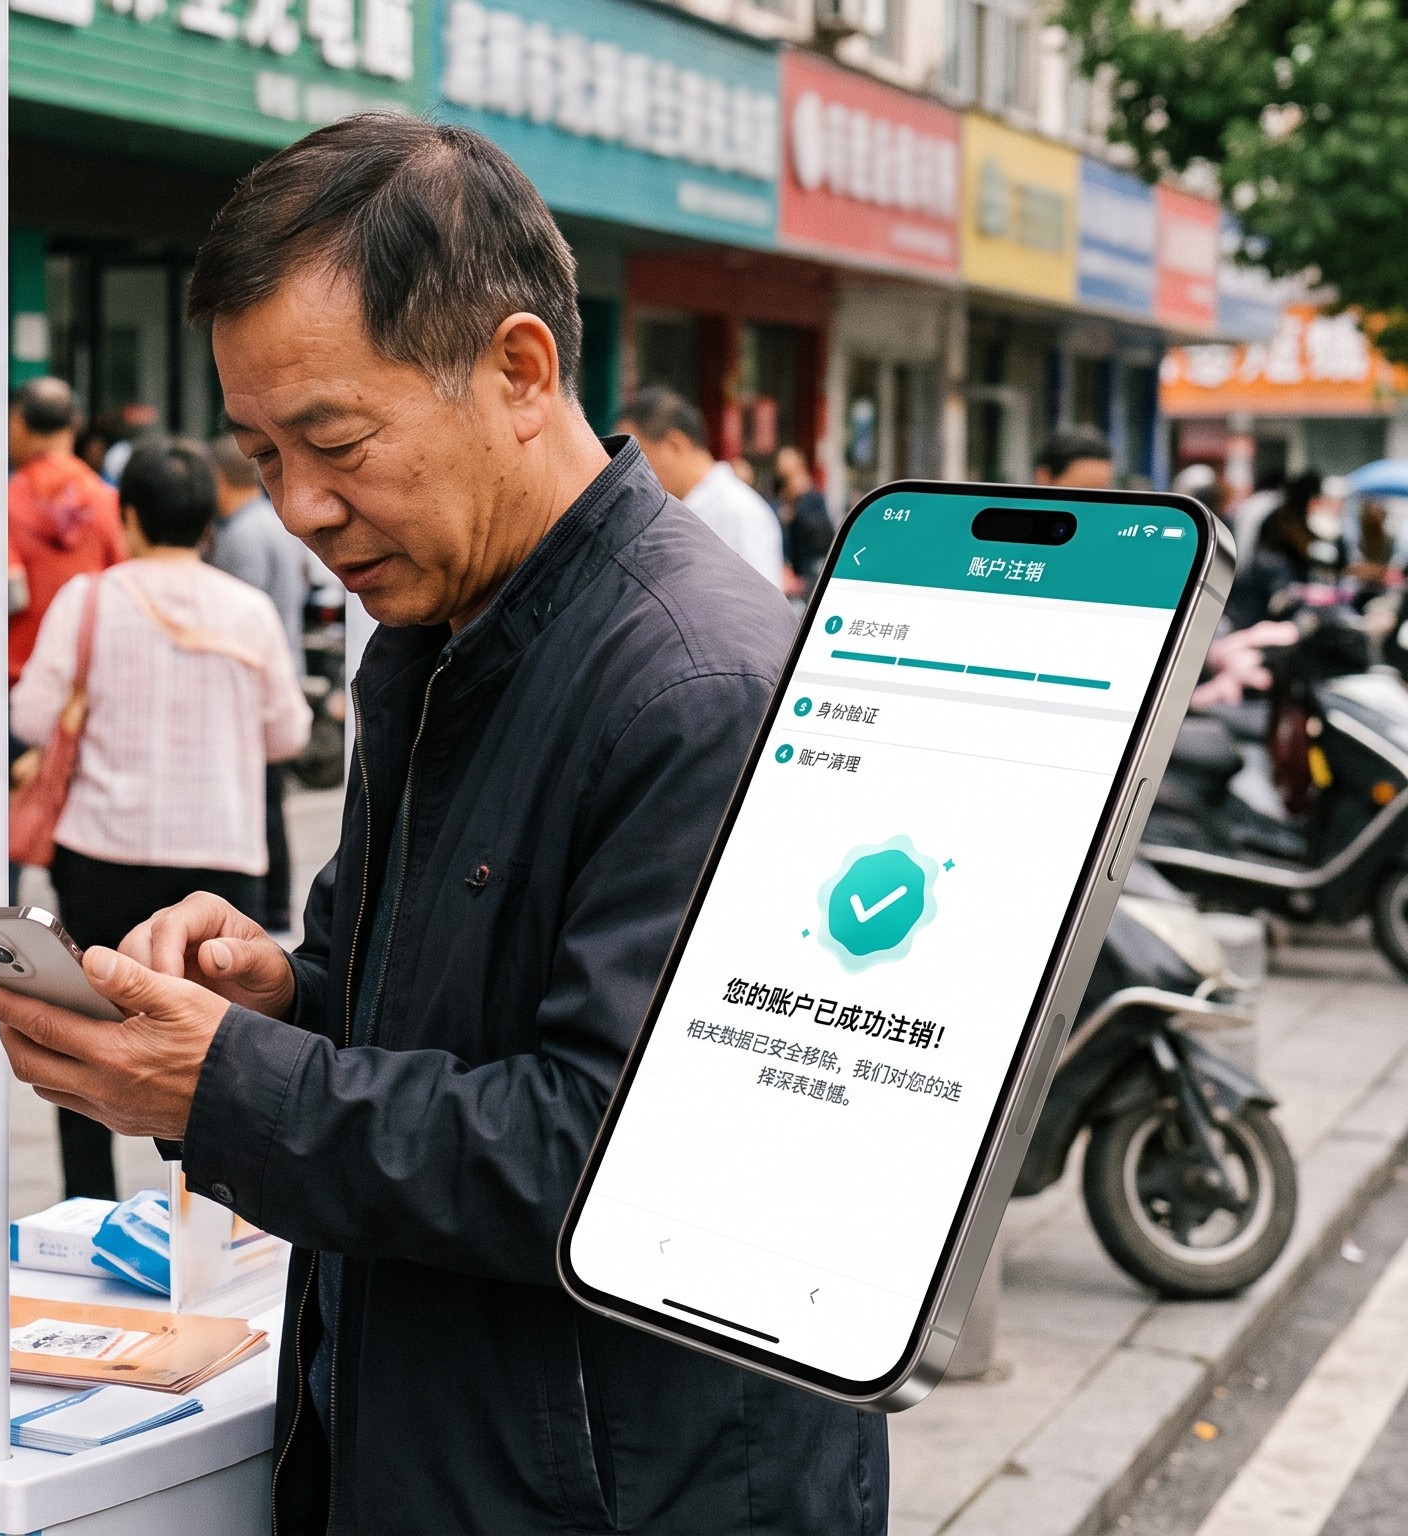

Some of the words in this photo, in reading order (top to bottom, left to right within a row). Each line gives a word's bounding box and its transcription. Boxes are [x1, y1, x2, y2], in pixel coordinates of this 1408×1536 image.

[883, 508, 911, 522] 9:41
[966, 556, 1046, 583] 账户注销
[815, 701, 880, 725] 身份验证
[796, 748, 862, 773] 账户清理
[756, 1065, 850, 1106] 择深表遗憾。
